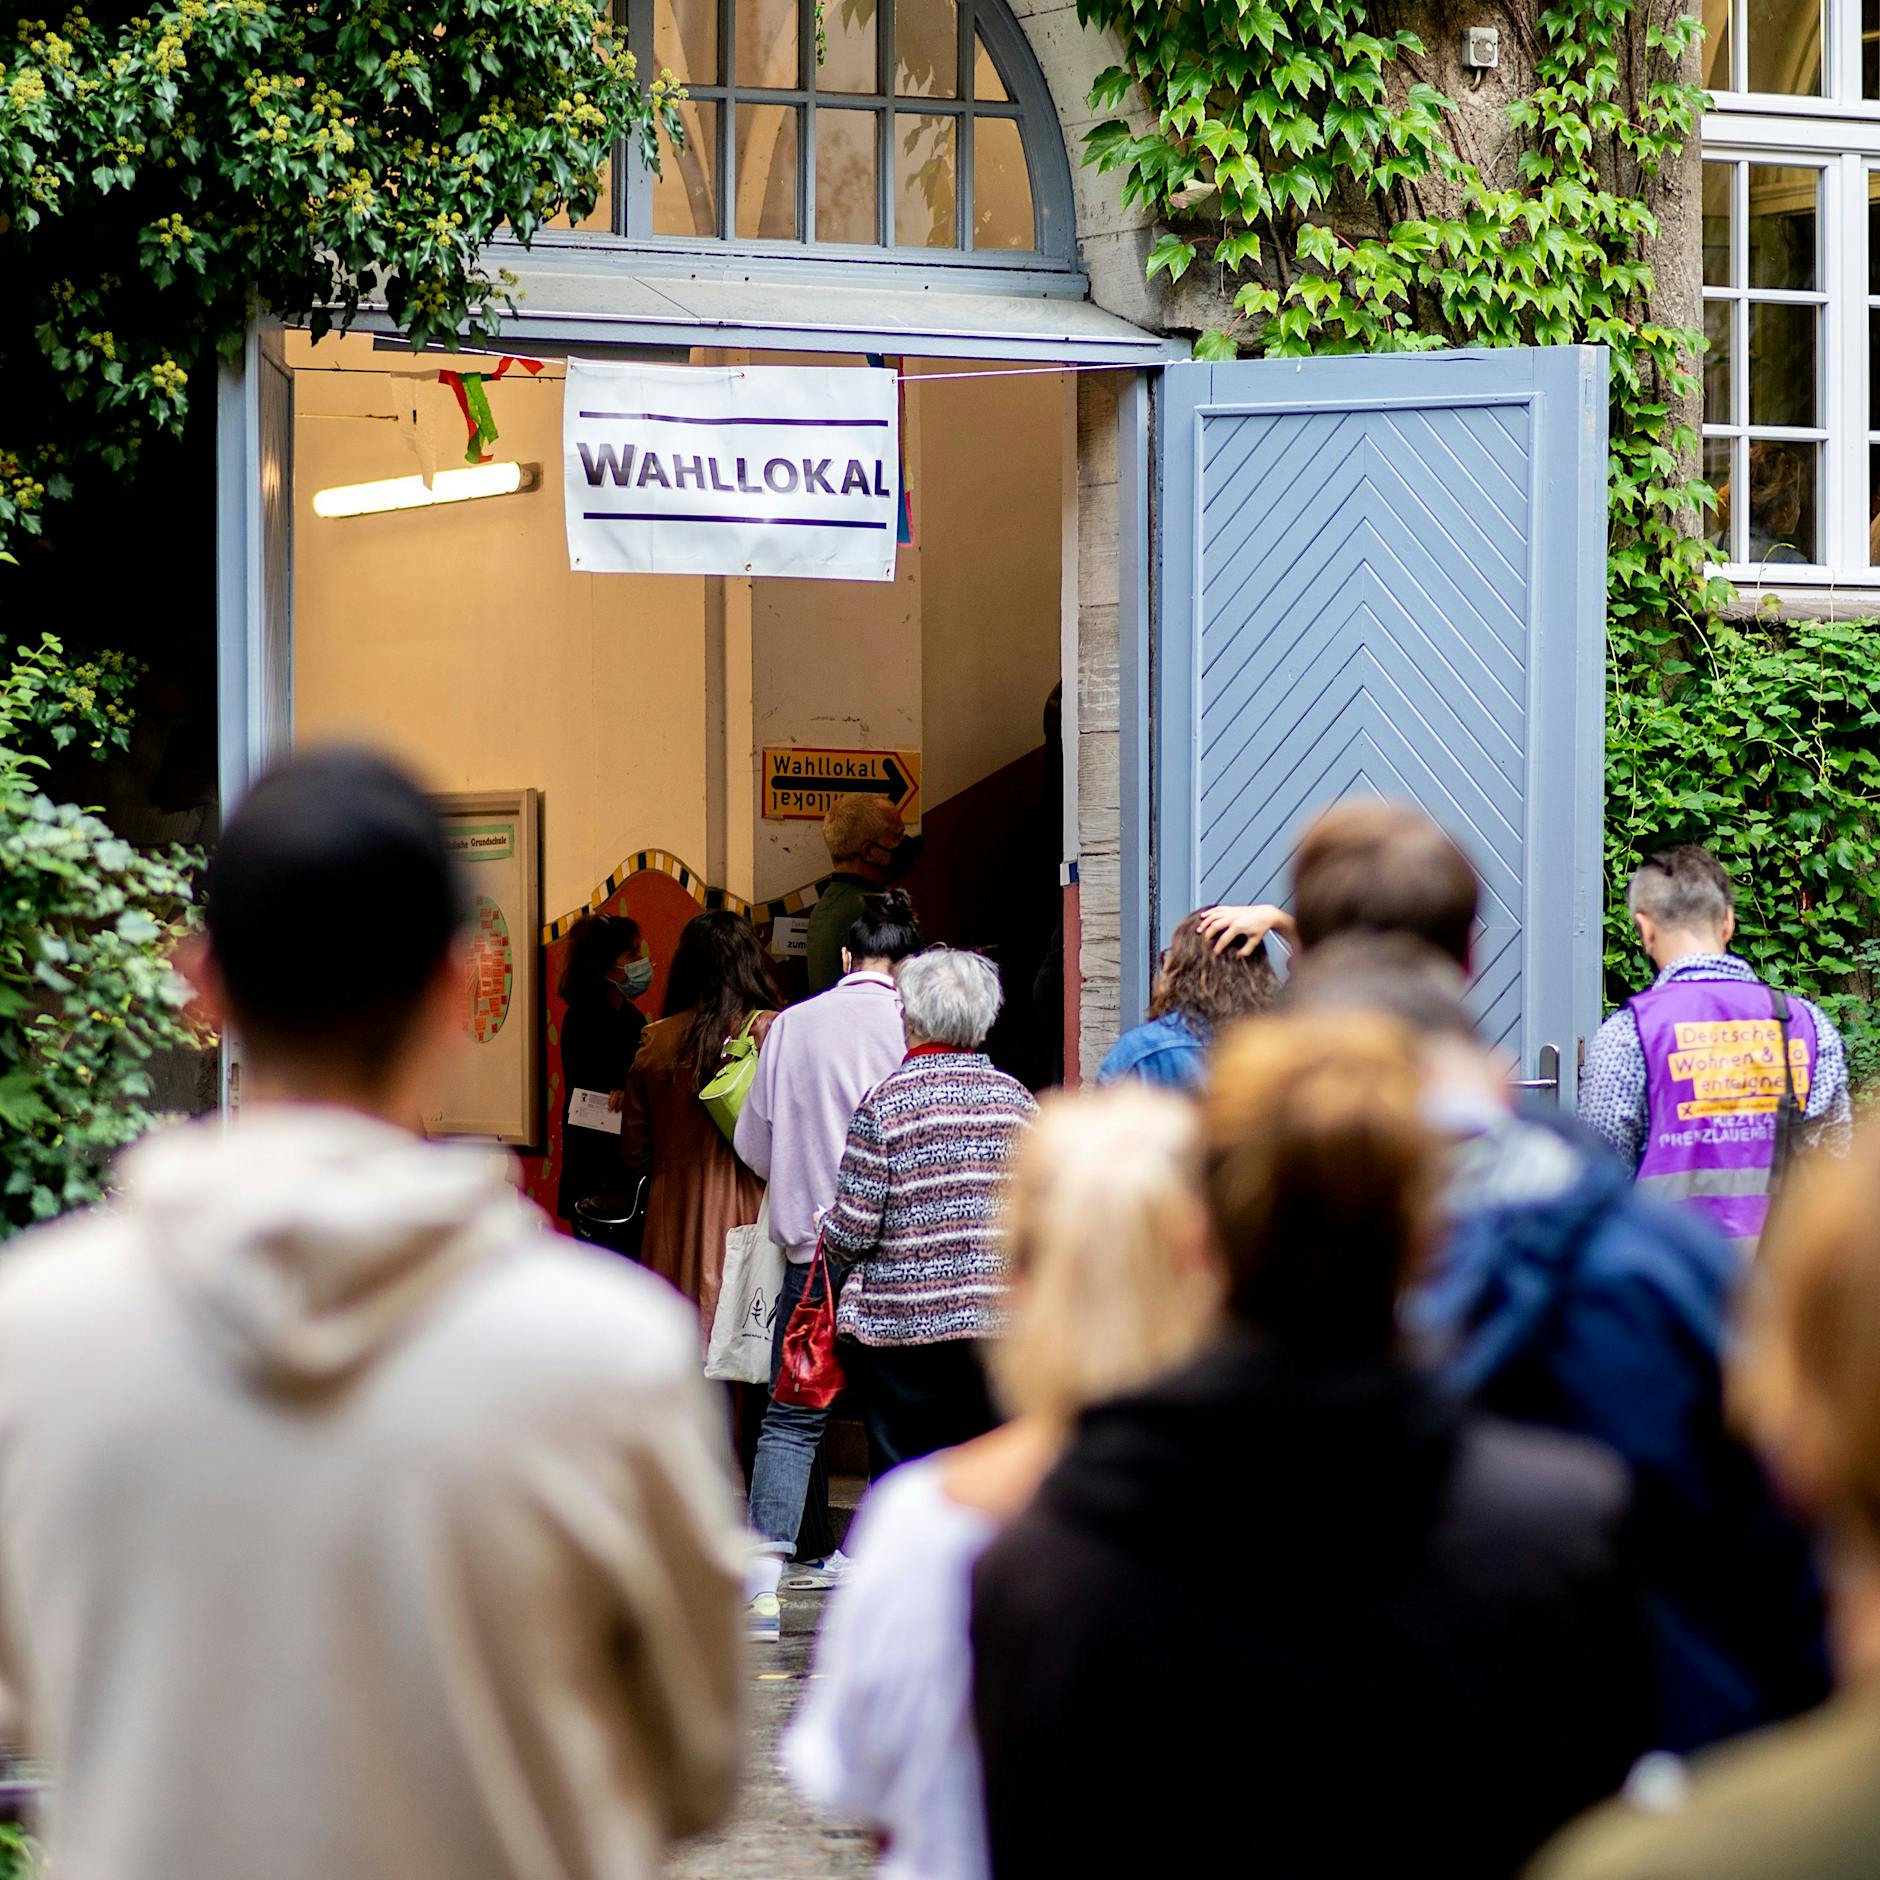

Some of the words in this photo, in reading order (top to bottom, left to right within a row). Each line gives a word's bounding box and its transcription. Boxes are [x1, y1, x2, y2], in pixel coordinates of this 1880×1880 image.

[576, 442, 891, 497] WAHLLOKAL
[773, 755, 876, 777] Wahllokal
[773, 791, 844, 811] llokal
[471, 836, 506, 846] Grundschule
[787, 941, 806, 949] zum
[1683, 1025, 1776, 1043] Deutsche
[1675, 1052, 1754, 1073] Wohnen
[1760, 1046, 1774, 1063] &
[1701, 1071, 1802, 1091] enteigne!
